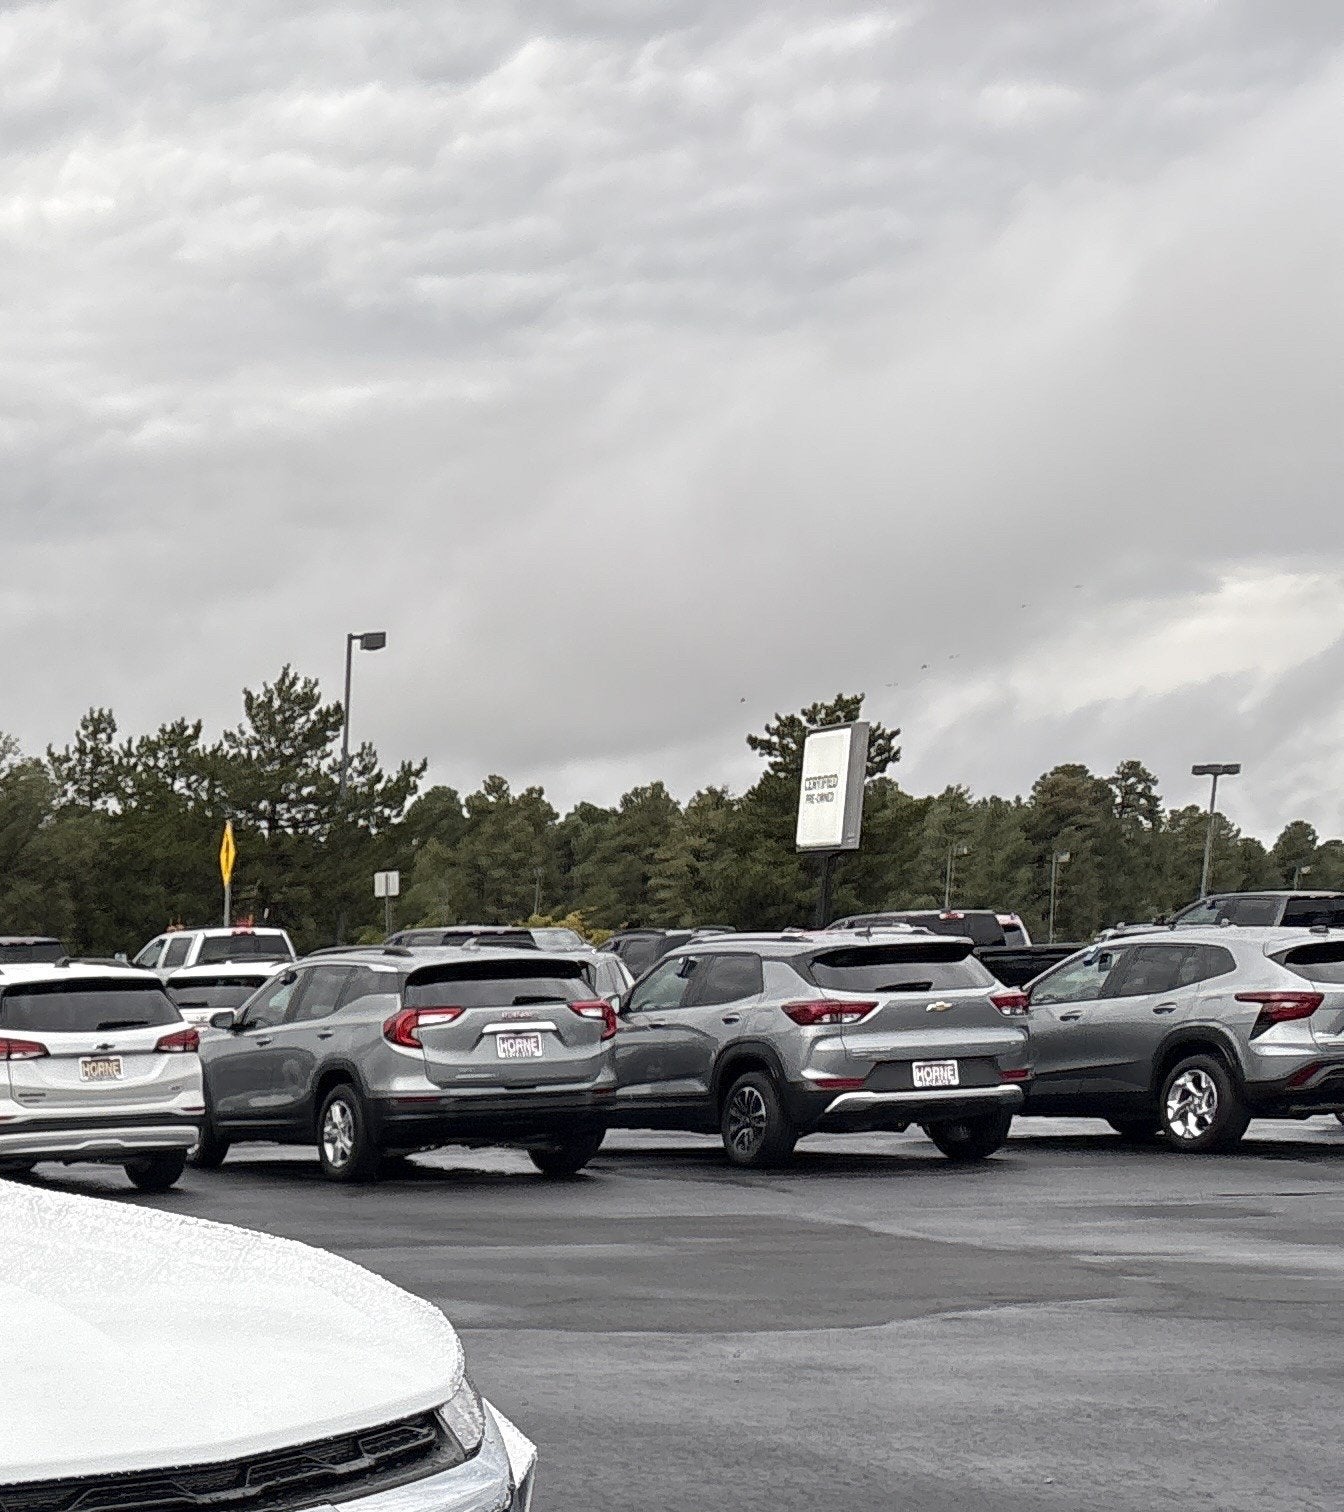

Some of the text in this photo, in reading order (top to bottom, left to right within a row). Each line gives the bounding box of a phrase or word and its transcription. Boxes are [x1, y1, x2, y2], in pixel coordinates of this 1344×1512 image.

[499, 1037, 538, 1051] HORNE
[81, 1059, 120, 1077] HORNE
[915, 1065, 955, 1081] HORNE
